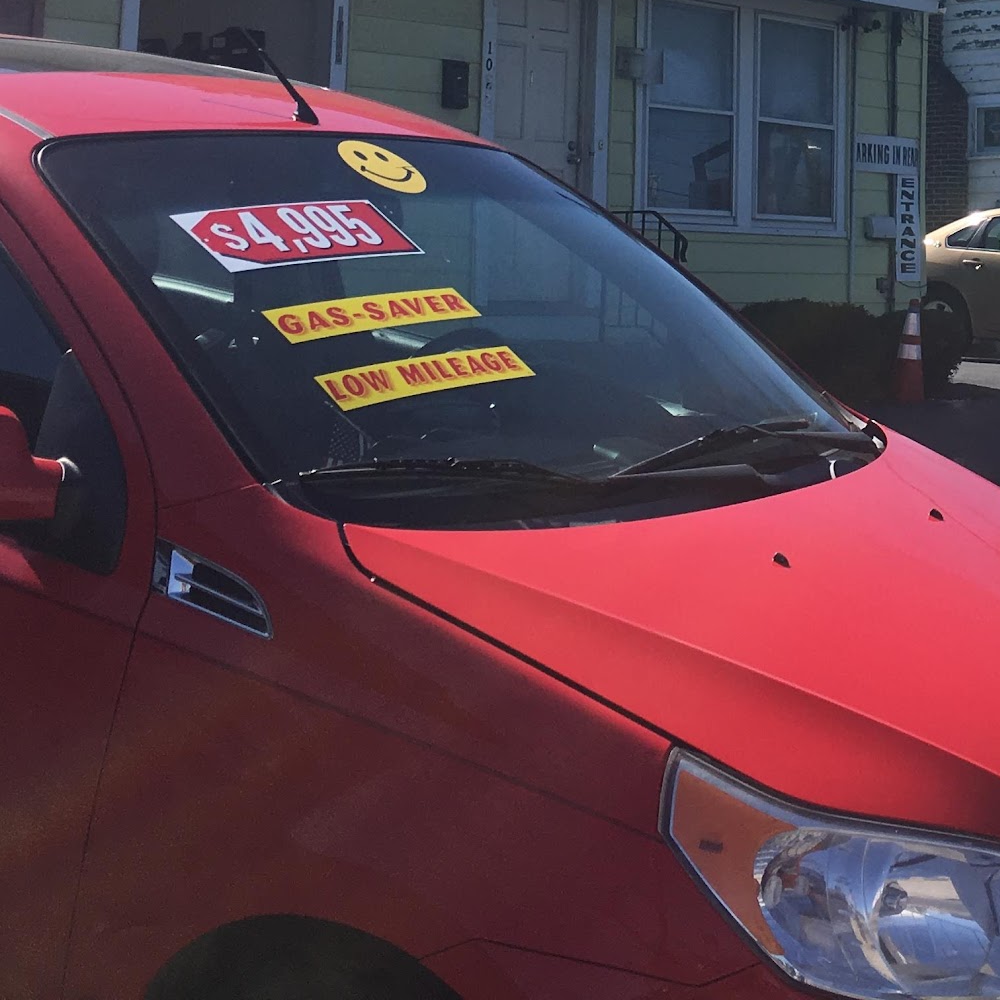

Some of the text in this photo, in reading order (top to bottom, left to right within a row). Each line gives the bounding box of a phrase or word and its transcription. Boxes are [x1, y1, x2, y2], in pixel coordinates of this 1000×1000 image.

[856, 142, 890, 165] ARKING
[892, 144, 902, 166] IN
[210, 204, 383, 254] $4,995
[901, 177, 917, 274] ENTRANCE
[277, 293, 468, 336] GAS-SAVER
[324, 350, 519, 402] LOW MILEAGE
